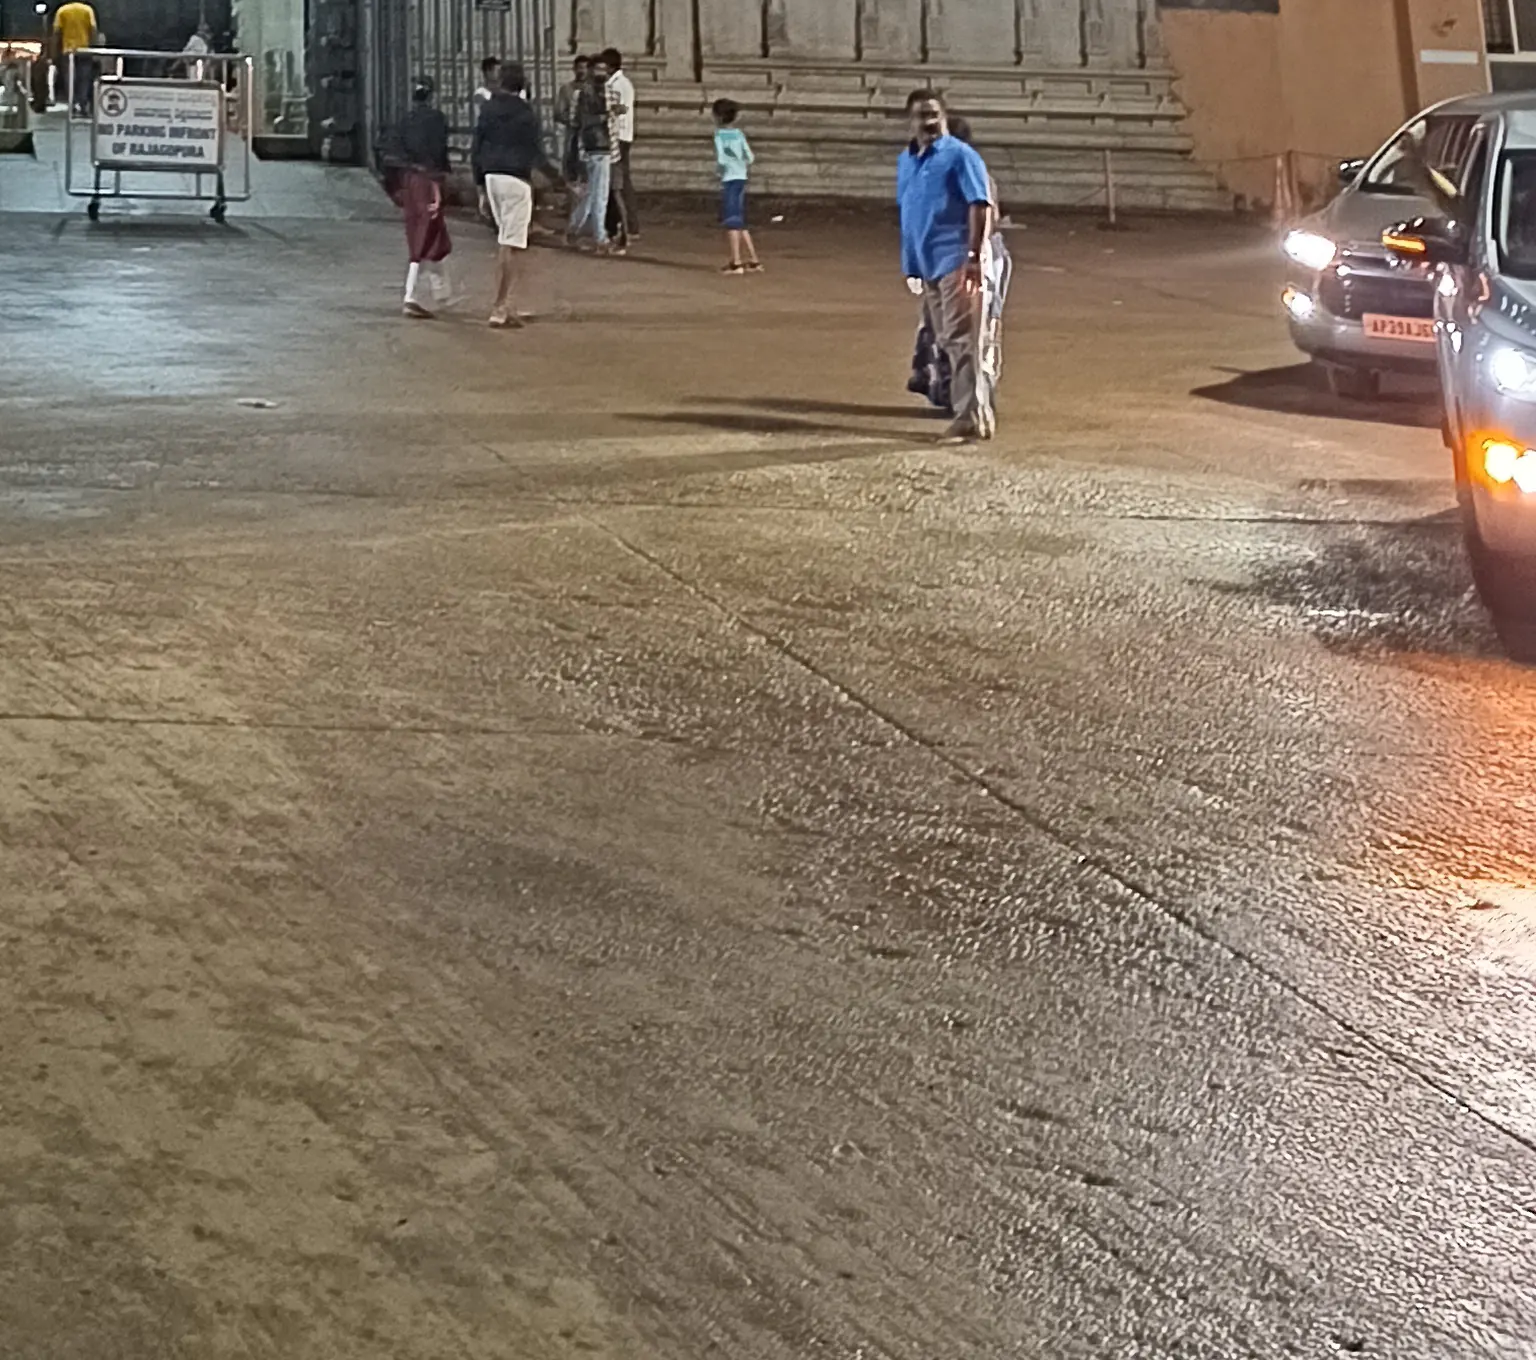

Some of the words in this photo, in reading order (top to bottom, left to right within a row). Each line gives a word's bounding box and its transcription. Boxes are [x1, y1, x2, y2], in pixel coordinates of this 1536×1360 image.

[97, 123, 114, 135] NO
[116, 123, 166, 138] PARKING
[112, 142, 126, 155] OF
[129, 143, 205, 158] RAJAGOPURA
